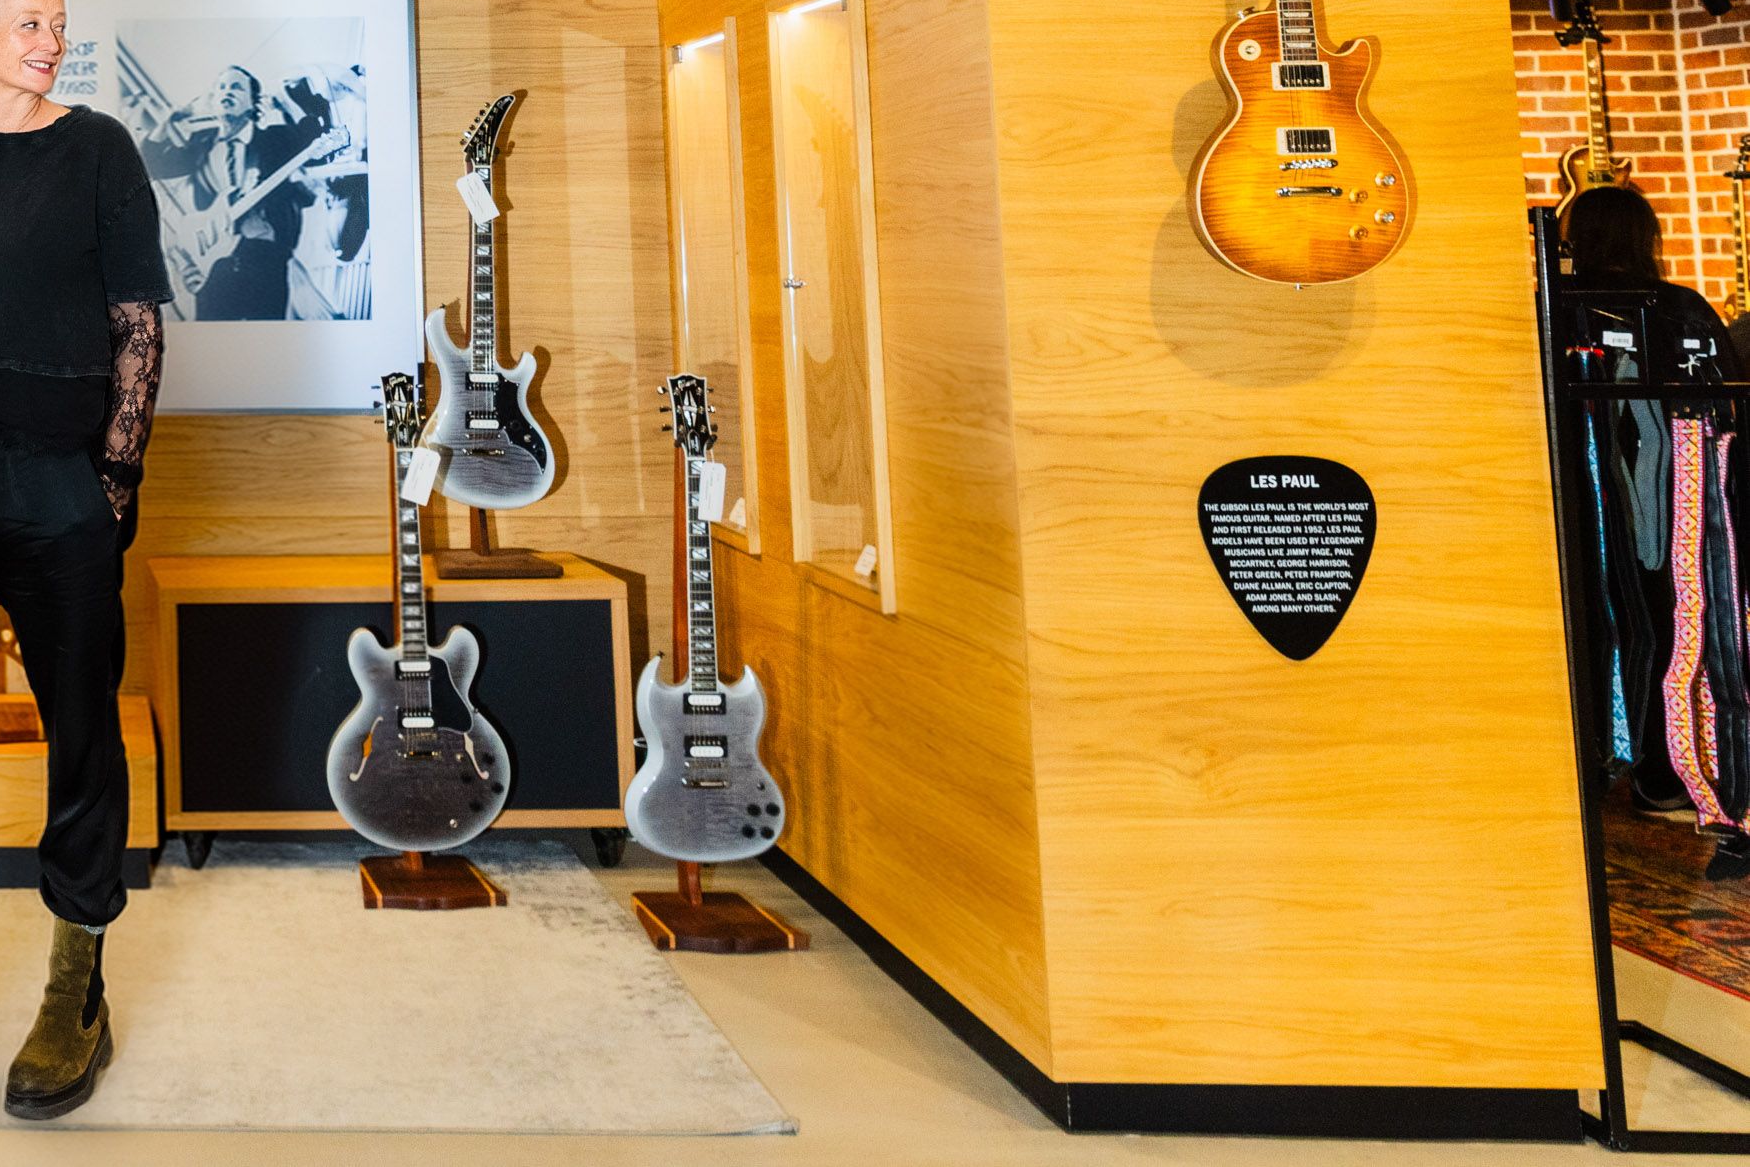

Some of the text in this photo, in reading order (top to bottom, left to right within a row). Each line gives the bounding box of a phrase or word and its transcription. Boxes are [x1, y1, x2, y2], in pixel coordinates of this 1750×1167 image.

[1250, 474, 1320, 488] LES PAUL
[1204, 502, 1369, 512] THE GIBSON LES PAUL IS THE WORLD'S MOST
[1211, 514, 1363, 523] FAMOUS GUITAR. NAMED AFTER LES PAUL
[1212, 526, 1229, 534] AND
[1230, 526, 1252, 534] FIRST
[1253, 526, 1292, 534] RELEASED
[1304, 525, 1326, 534] 1952,
[1326, 525, 1341, 534] LES
[1342, 525, 1362, 533] PAUL
[1211, 536, 1364, 545] MODELS HAVE BEEN USED BY LEGENDARY
[1224, 548, 1354, 556] MUSICIANS LIKE JIMMY PAGE, PAUL
[1230, 559, 1350, 568] MCCARTNEY, GEORGE HARRISON,
[1229, 570, 1353, 579] PETER GREEN, PETER FRAMPTON,
[1233, 582, 1351, 590] DUANE ALLMAN, ERIC CLAPTON,
[1245, 593, 1341, 602] ADAM JONES, AND SLASH,
[1252, 604, 1337, 613] AMONG MANY OTHERS.
